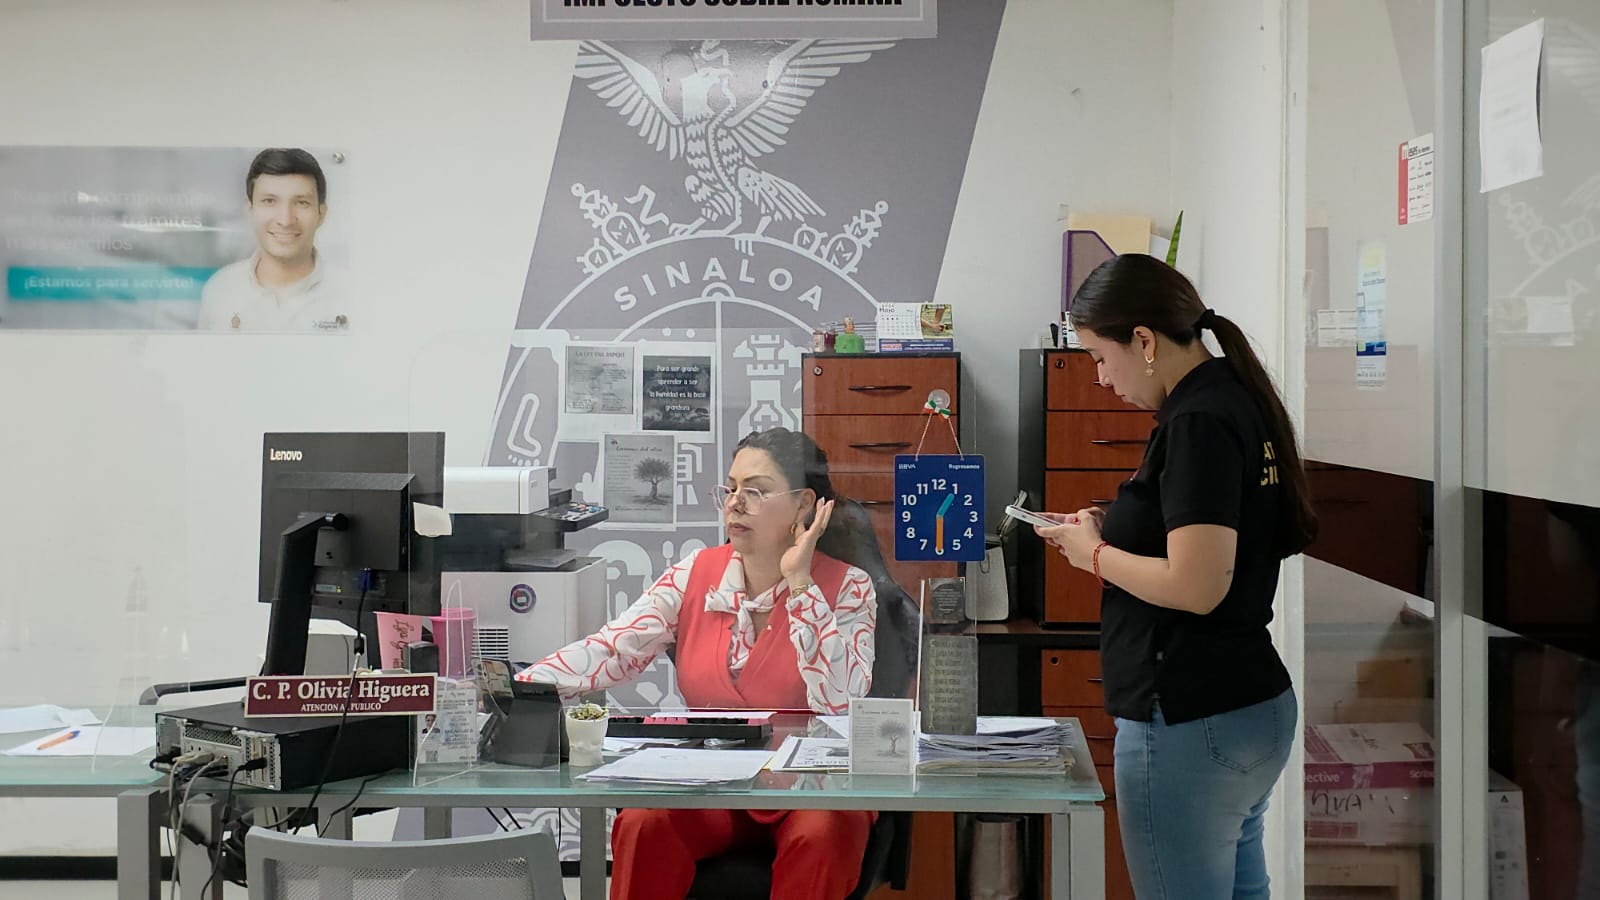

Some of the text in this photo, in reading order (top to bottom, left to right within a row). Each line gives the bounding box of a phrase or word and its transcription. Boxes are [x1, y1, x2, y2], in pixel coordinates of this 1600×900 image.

[24, 276, 194, 291] ¡Estamos para servirte!
[614, 257, 823, 312] SINALOA
[270, 448, 303, 461] Lenovo
[916, 483, 928, 495] 11
[931, 479, 947, 490] 12
[952, 483, 958, 495] 1
[901, 494, 917, 506] 10
[963, 494, 973, 506] 2
[901, 511, 911, 522] 9
[969, 511, 978, 522] 3
[906, 527, 916, 539] 8
[963, 527, 974, 539] 4
[919, 539, 928, 550] 7
[952, 539, 961, 551] 5
[253, 682, 271, 700] C.
[277, 681, 292, 700] P.
[297, 680, 353, 700] Olivia
[358, 679, 430, 702] Higuera
[301, 703, 339, 712] ATENCION
[351, 702, 382, 711] PUBLICO
[1305, 770, 1340, 783] ective
